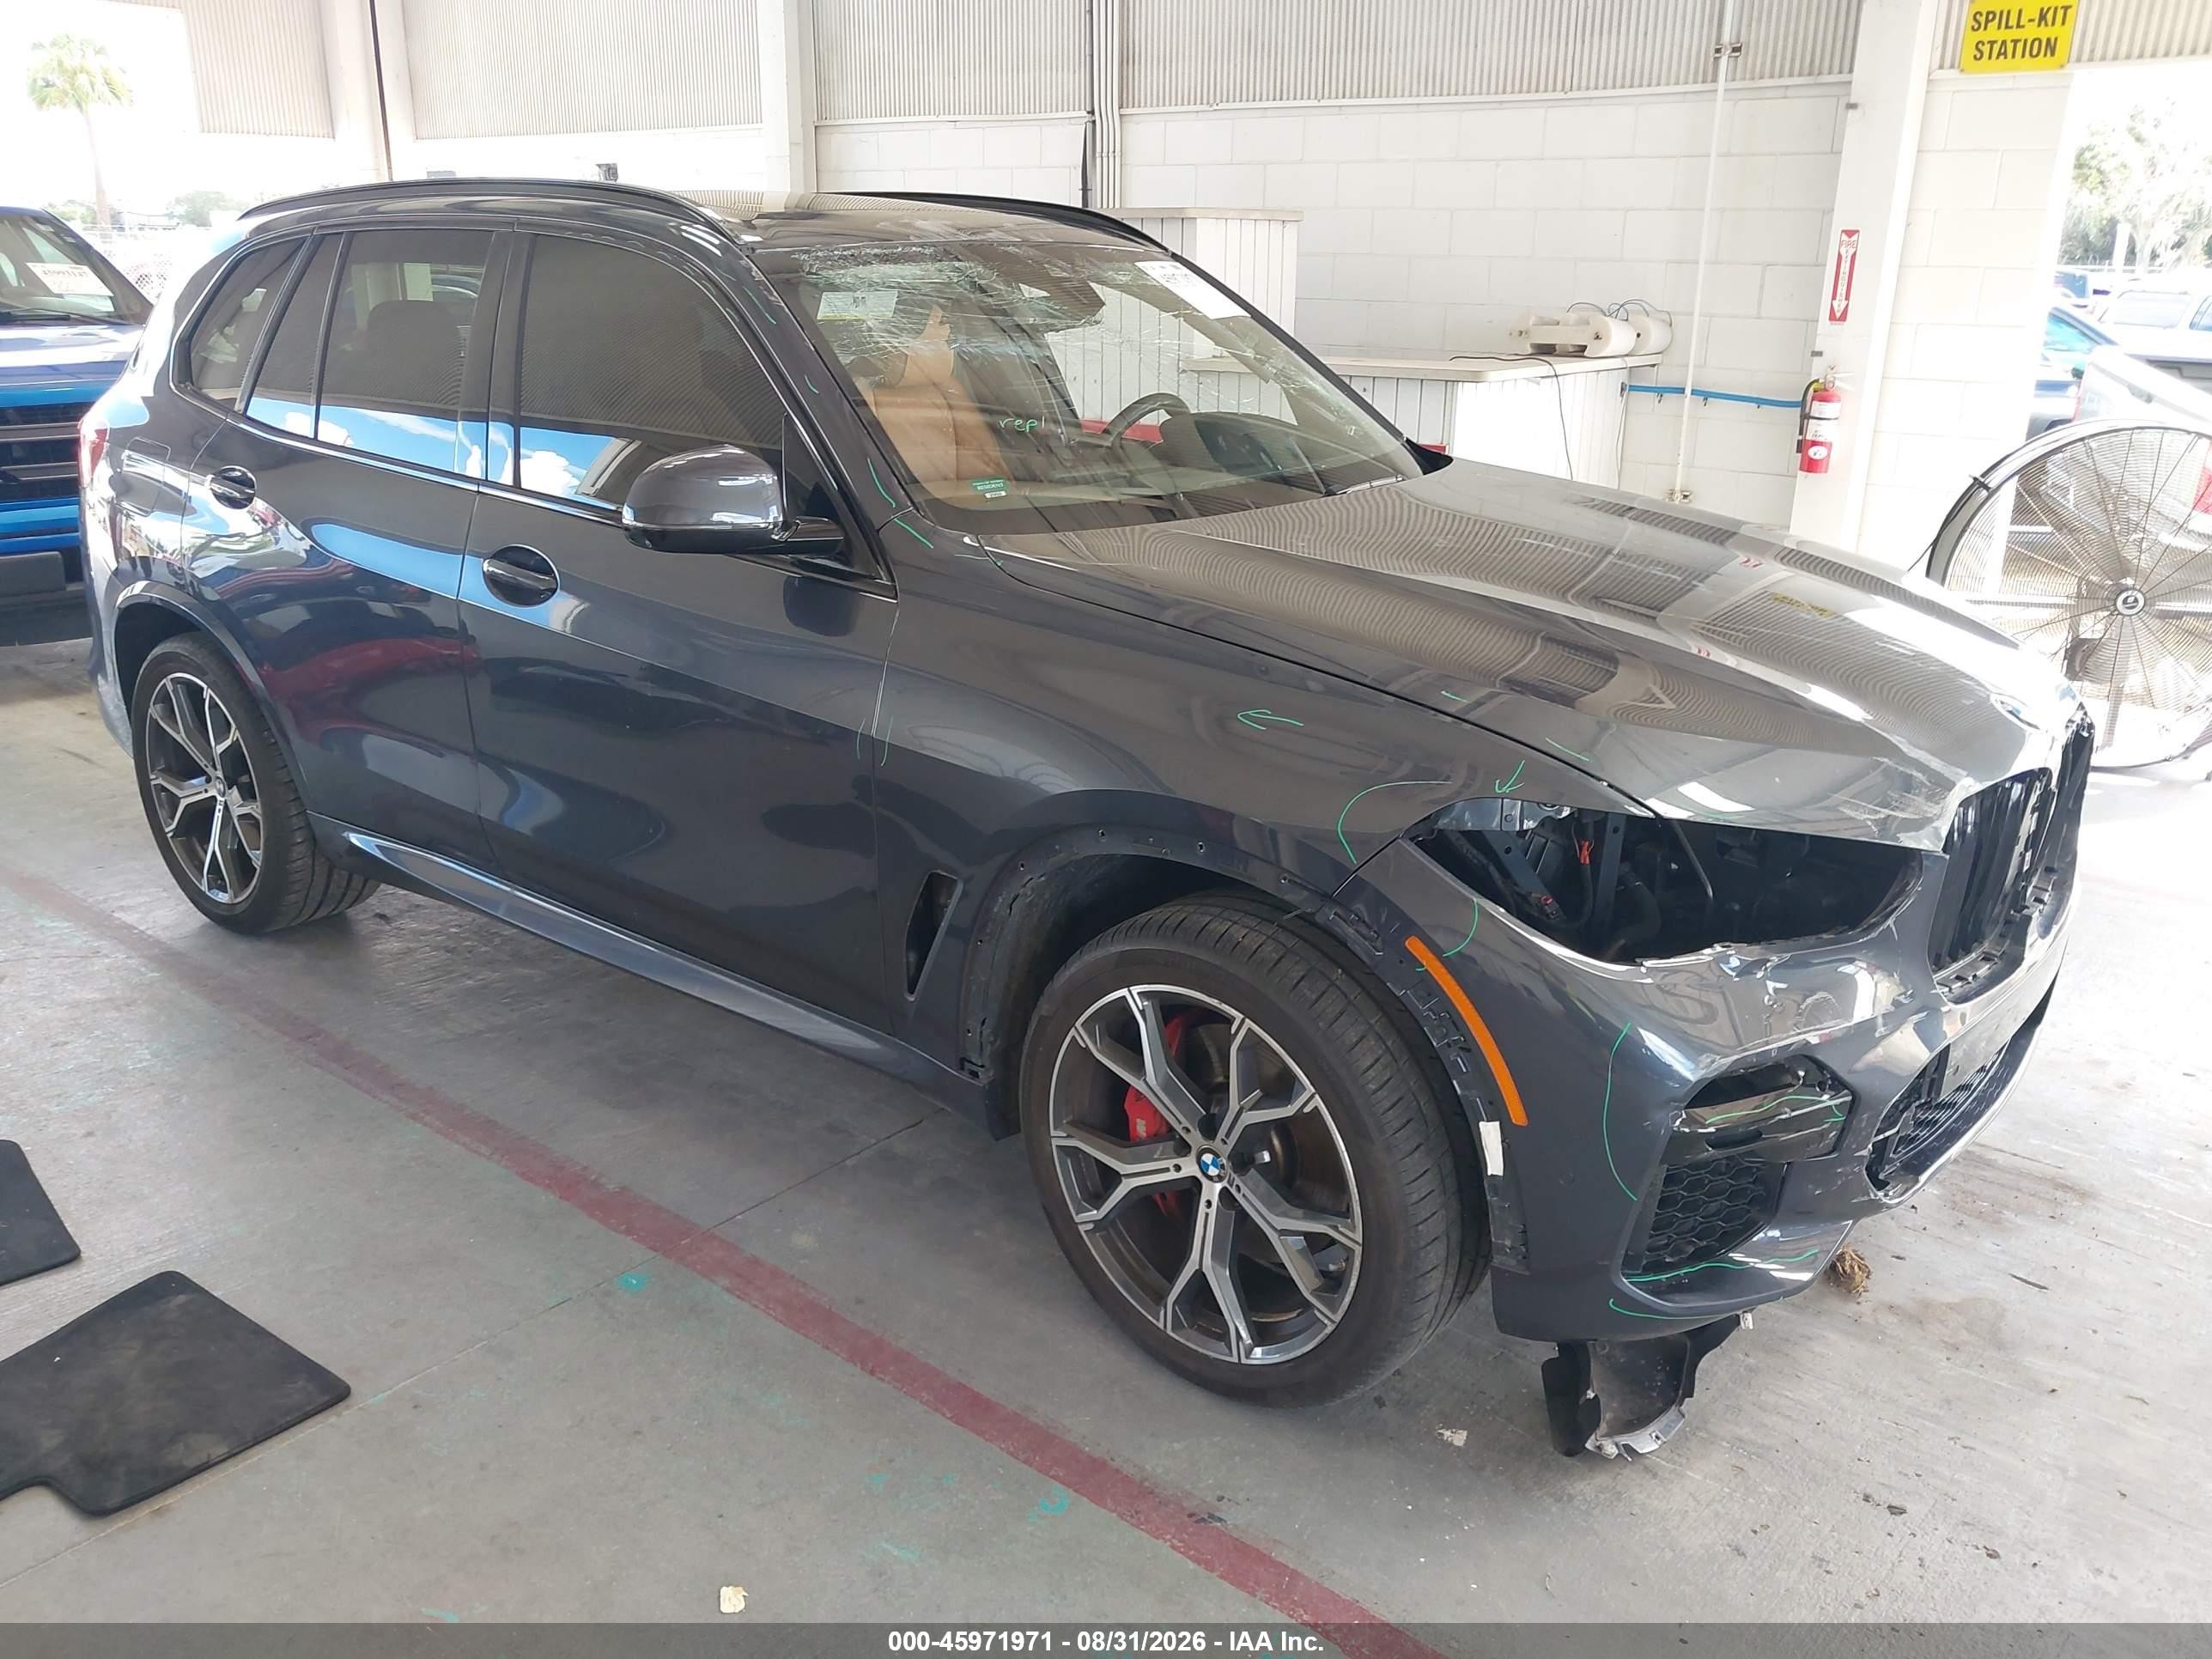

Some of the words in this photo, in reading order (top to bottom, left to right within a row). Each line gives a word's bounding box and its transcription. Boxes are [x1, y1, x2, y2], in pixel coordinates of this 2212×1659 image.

[1971, 4, 2073, 32] SPILL-KIT
[1972, 36, 2059, 62] STATION
[1840, 240, 1857, 249] FIRE
